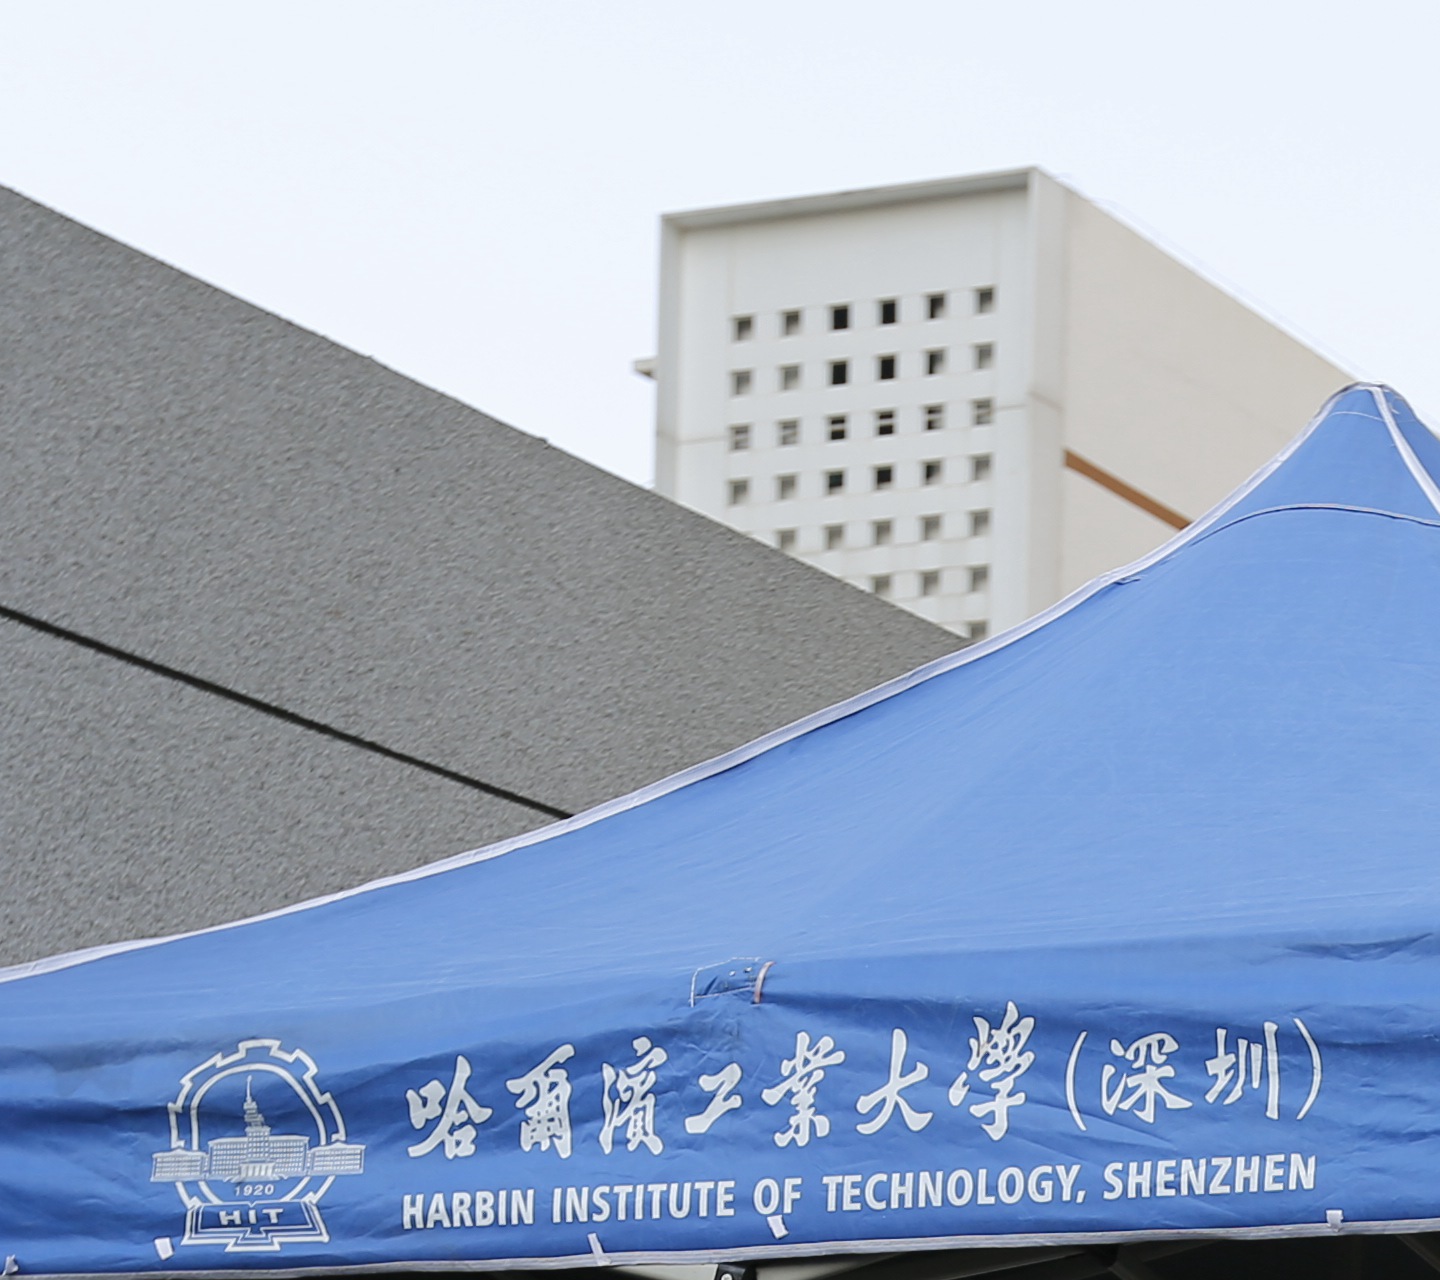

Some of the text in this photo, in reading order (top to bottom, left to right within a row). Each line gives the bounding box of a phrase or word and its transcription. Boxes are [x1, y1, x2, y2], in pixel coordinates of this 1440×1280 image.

[234, 1183, 275, 1197] 1920
[402, 1153, 1317, 1230] HARBIN INSTITUTE OF TECHNOLOGY, SHENZHEN
[219, 1208, 284, 1226] HIT
